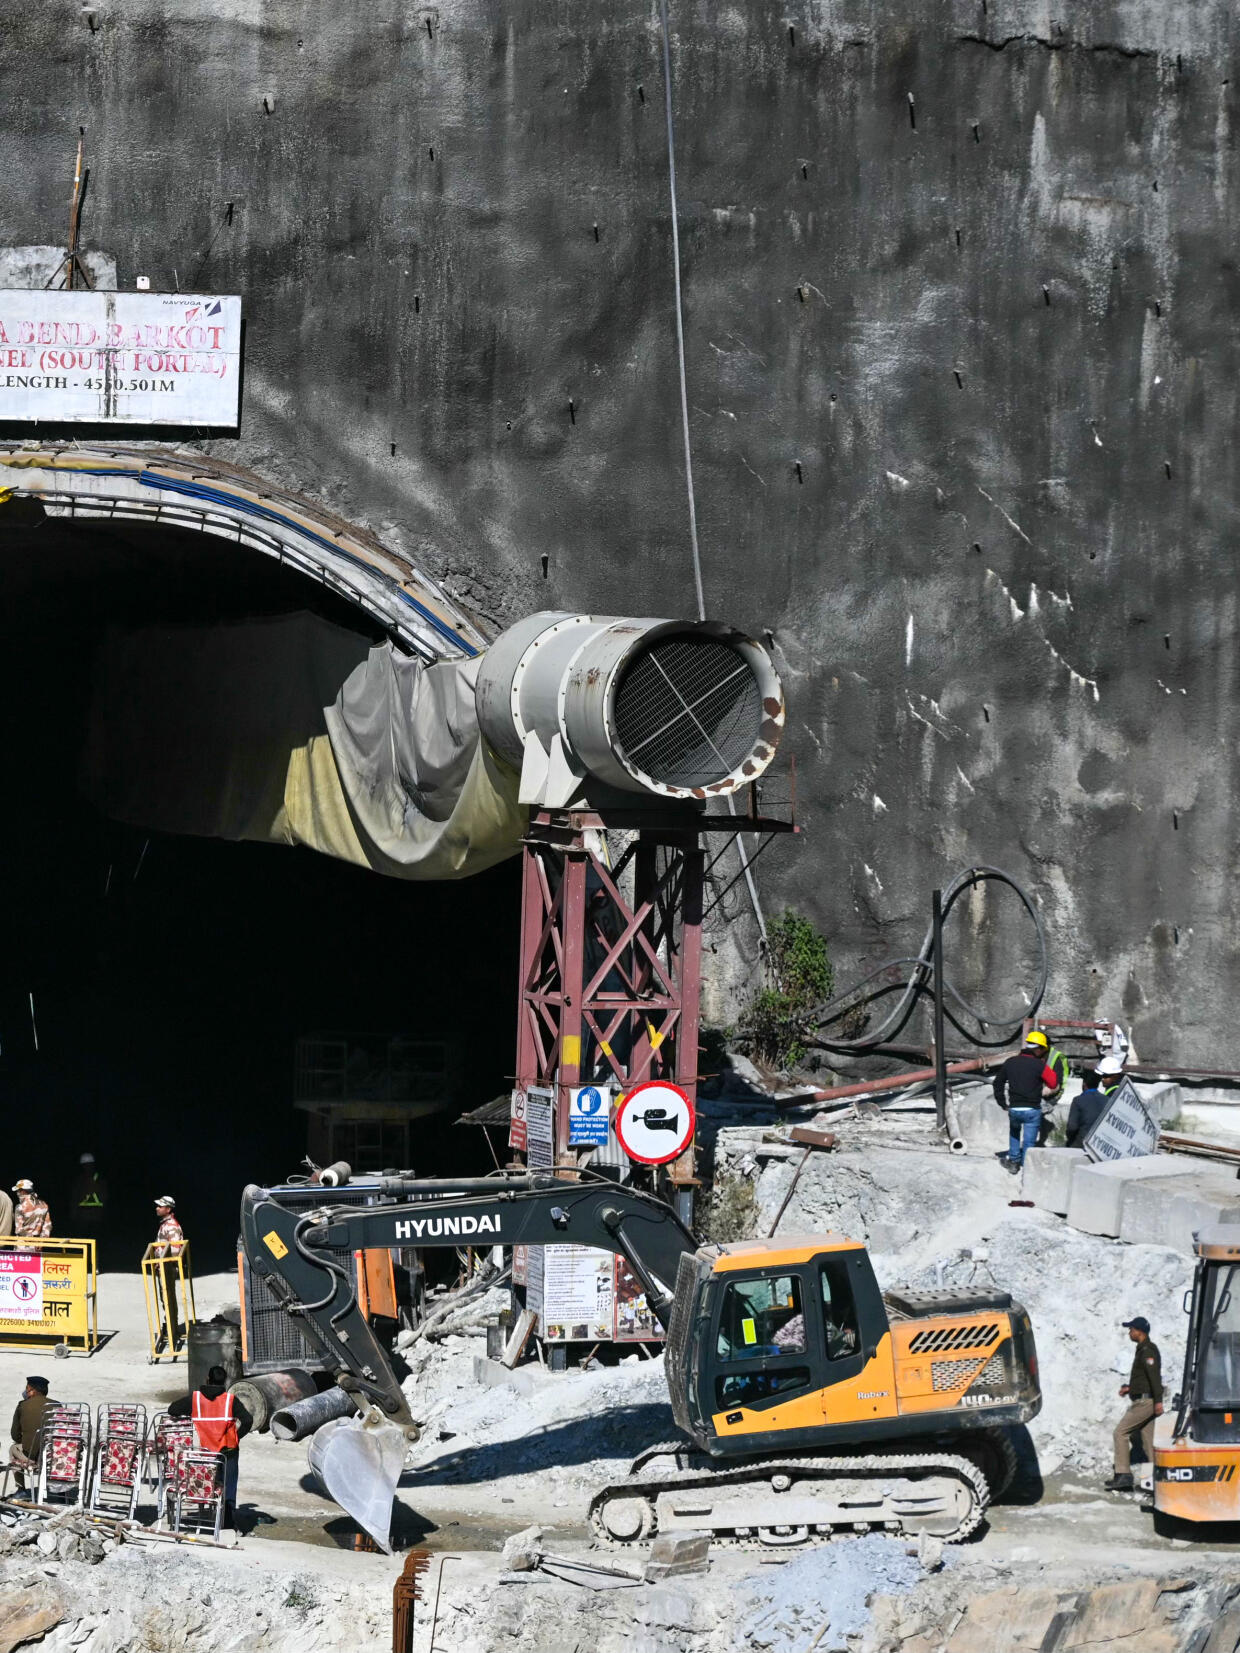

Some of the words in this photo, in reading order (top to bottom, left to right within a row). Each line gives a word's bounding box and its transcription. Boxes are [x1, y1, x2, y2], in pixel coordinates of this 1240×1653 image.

[1105, 1111, 1137, 1140] ALOMAX
[395, 1214, 502, 1239] HYUNDAI
[1166, 1468, 1193, 1481] HD
